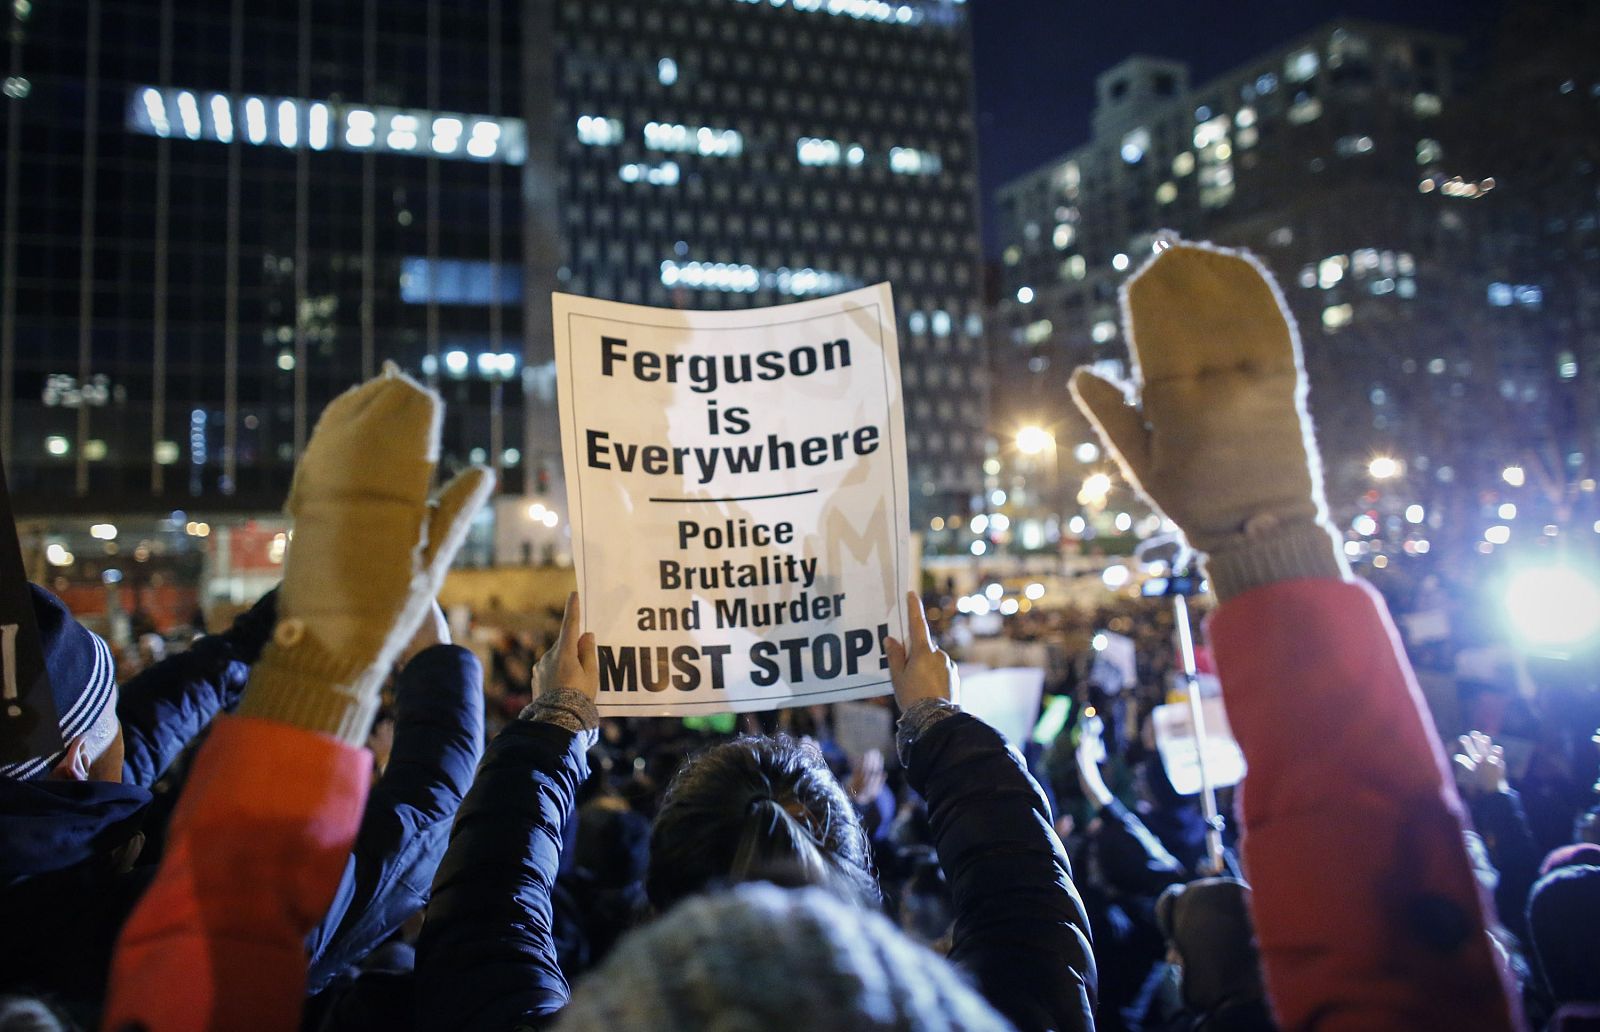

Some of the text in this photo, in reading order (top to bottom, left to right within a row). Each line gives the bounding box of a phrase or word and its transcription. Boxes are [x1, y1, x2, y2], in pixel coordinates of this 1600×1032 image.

[600, 336, 851, 393] Ferguson
[708, 400, 751, 435] is
[586, 424, 880, 484] Everywhere
[678, 520, 794, 549] Police
[659, 555, 818, 590] Brutality
[637, 592, 846, 632] and Murder
[597, 623, 889, 692] MUST STOP!
